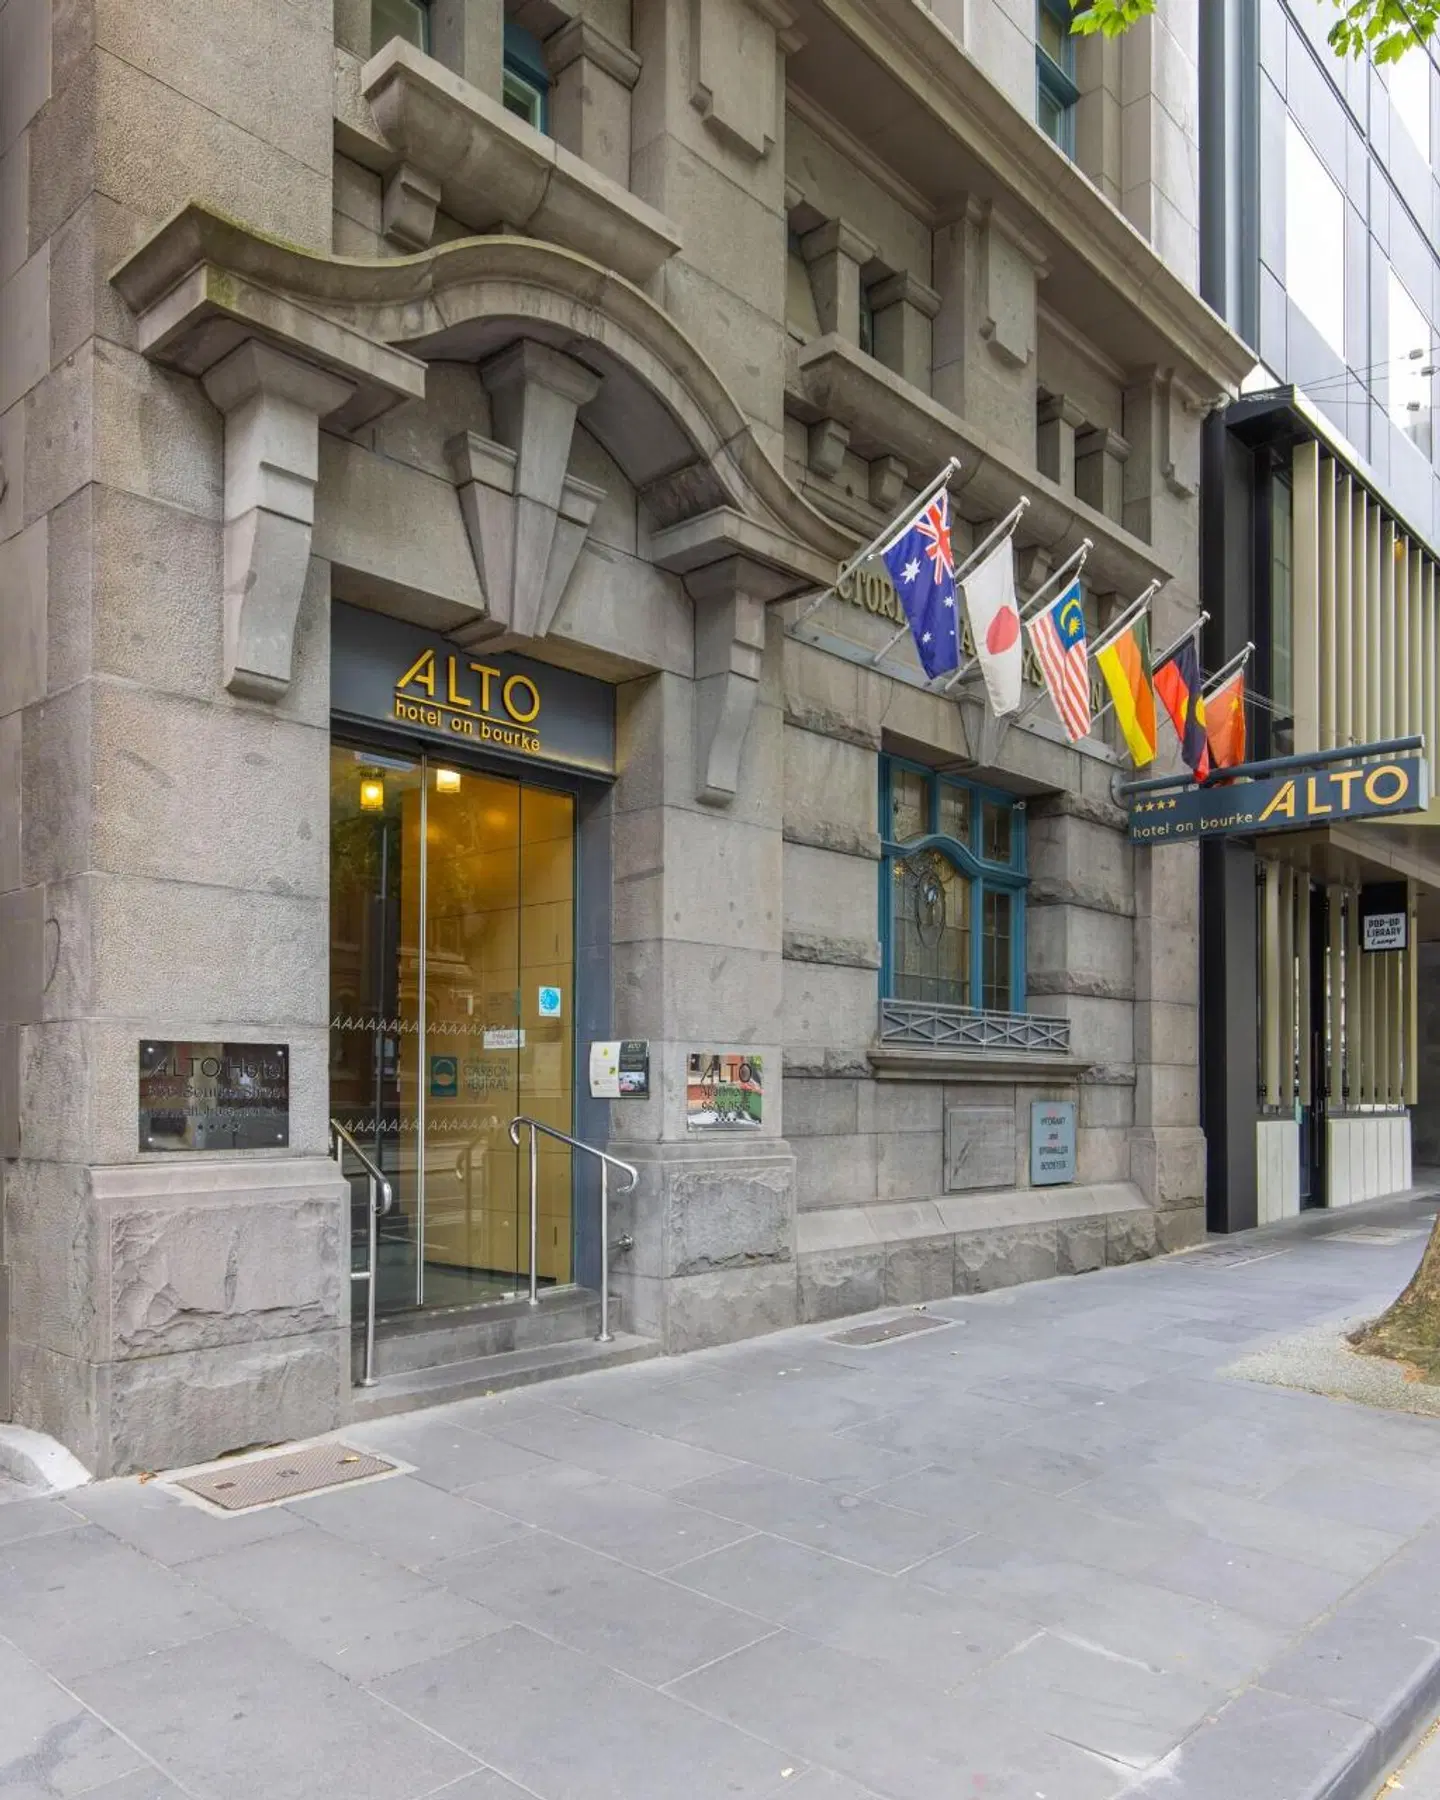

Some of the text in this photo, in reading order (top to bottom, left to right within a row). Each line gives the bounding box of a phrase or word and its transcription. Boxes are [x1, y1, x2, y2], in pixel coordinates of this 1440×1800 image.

[395, 649, 541, 724] ALTO
[395, 699, 541, 752] hotel on bourke
[1133, 764, 1410, 839] hotel on bourke ALTO
[1366, 926, 1402, 938] LIBRARY
[1368, 917, 1401, 929] POP-UP
[149, 1055, 286, 1079] ALTO Hotel
[700, 1062, 752, 1084] ALTO
